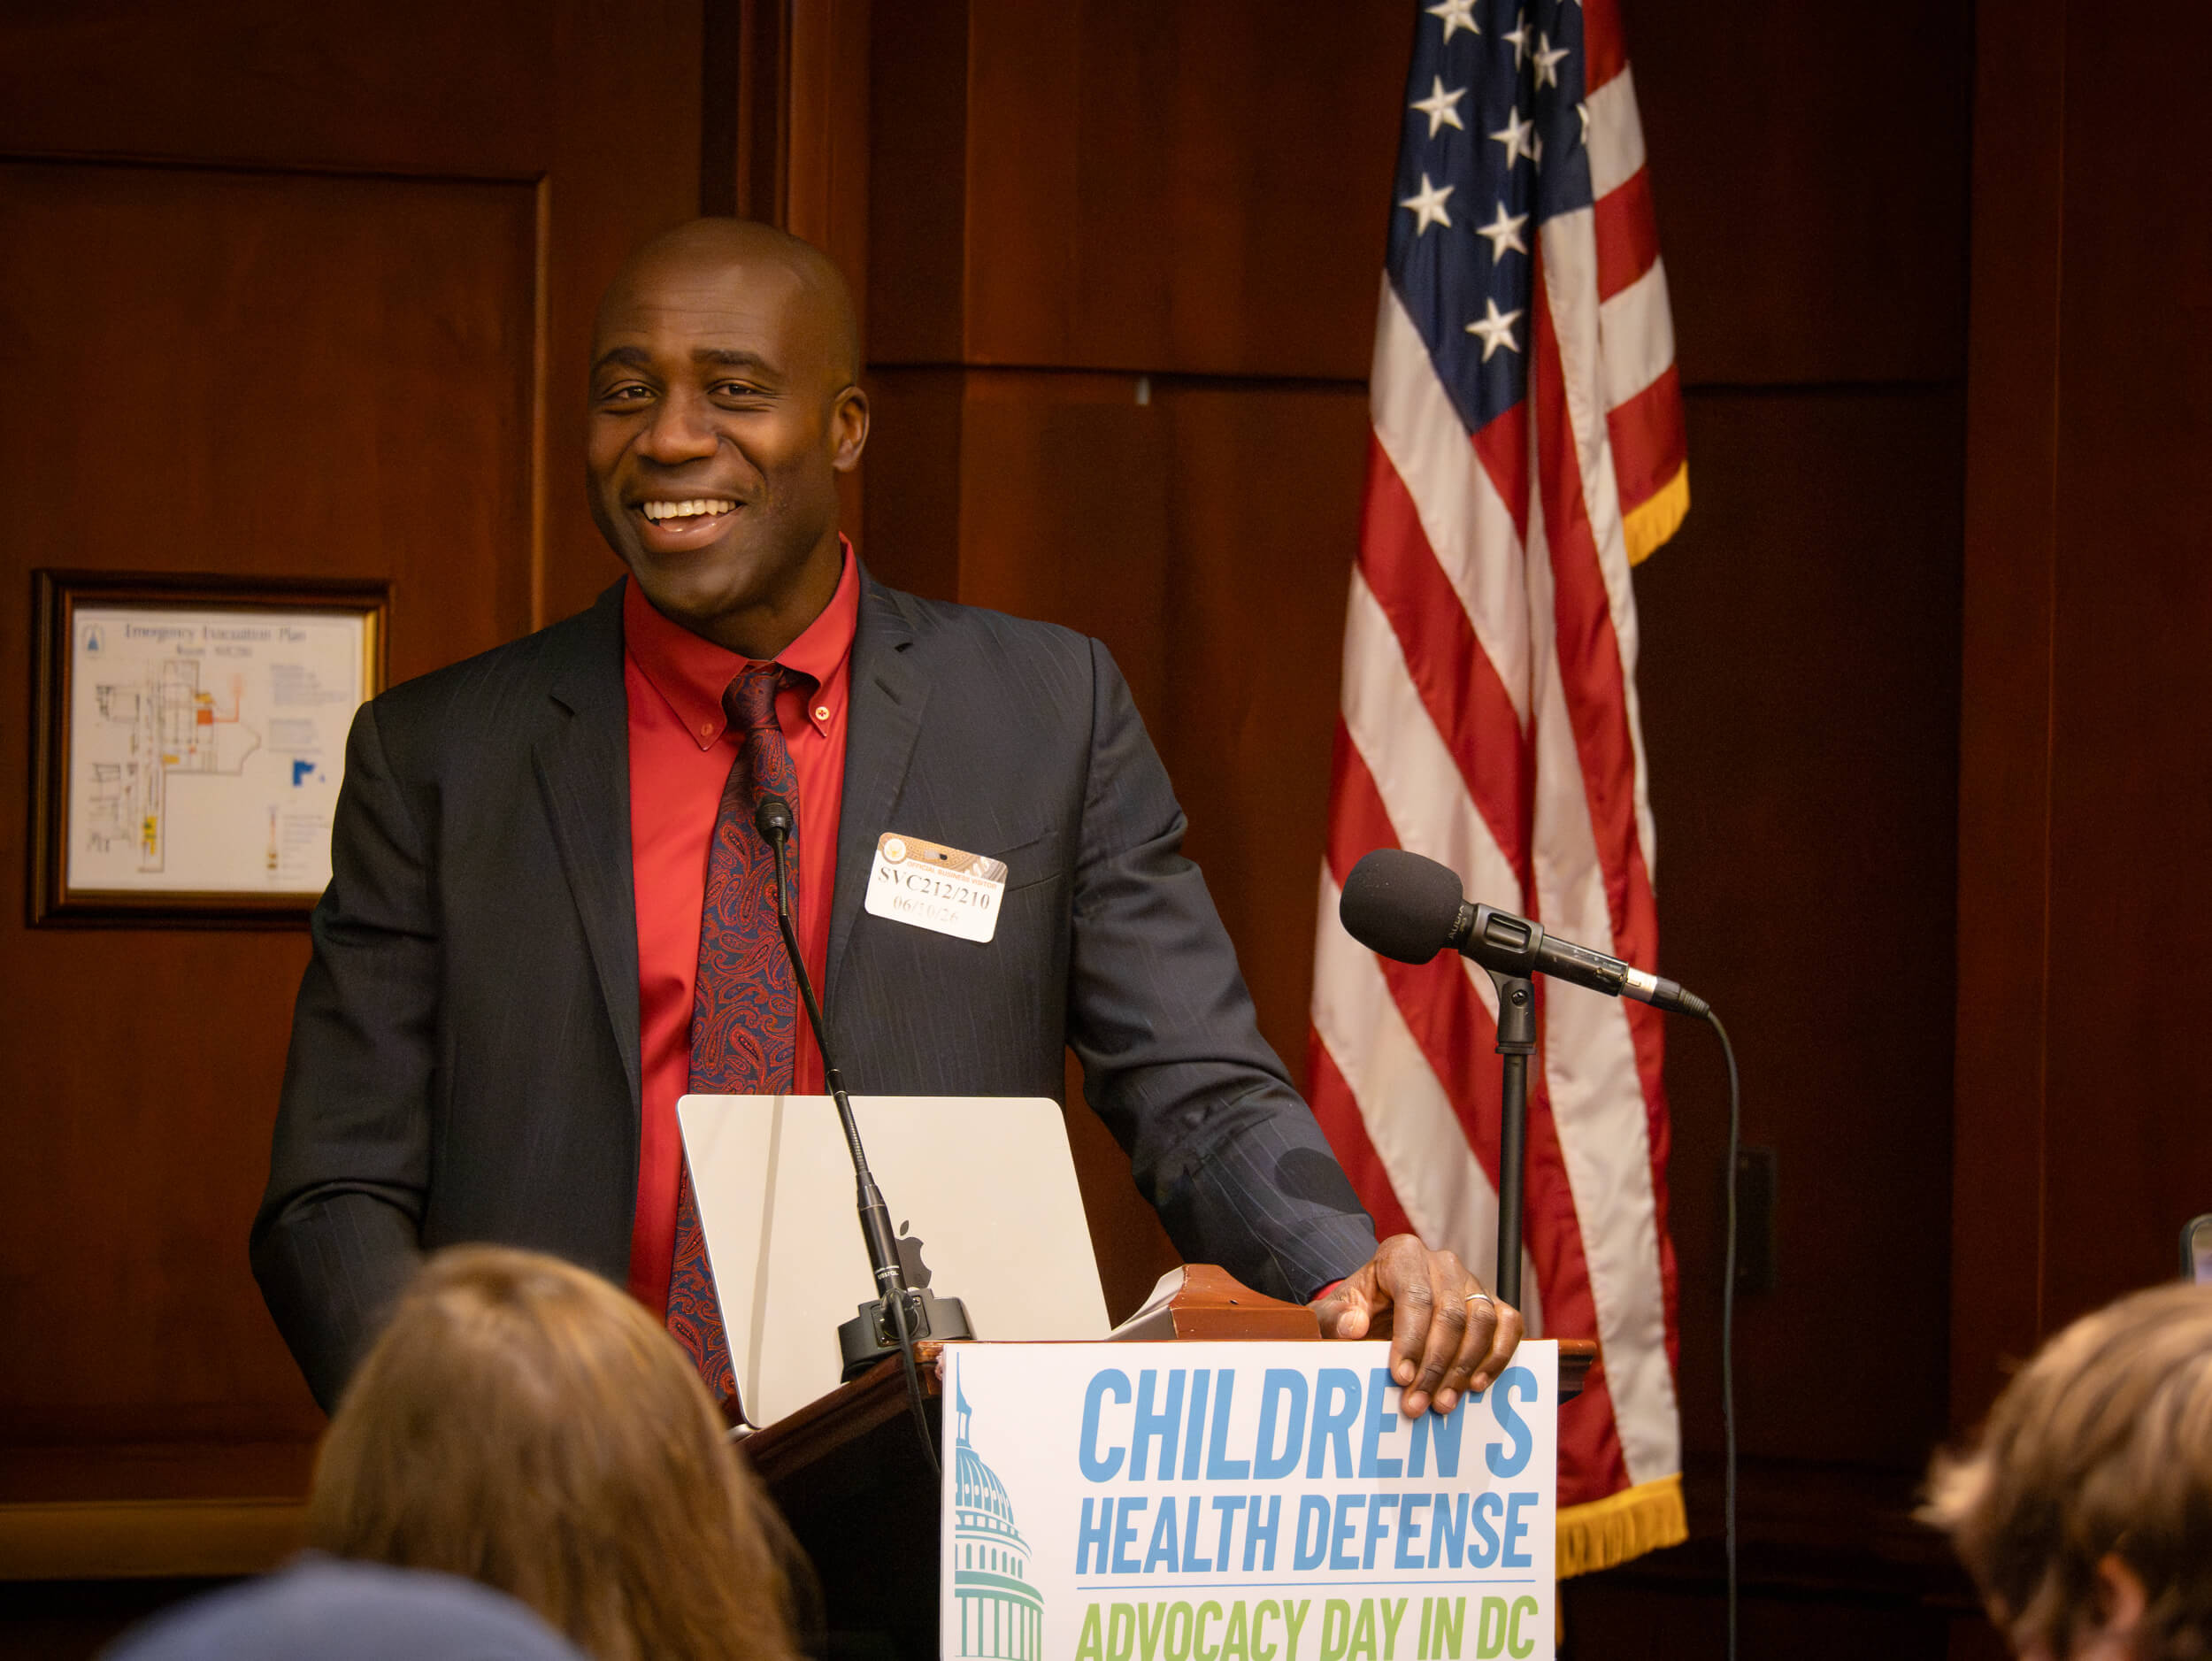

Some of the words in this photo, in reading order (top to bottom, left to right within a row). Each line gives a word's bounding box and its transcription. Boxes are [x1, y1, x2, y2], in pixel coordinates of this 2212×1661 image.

[124, 623, 196, 642] Emergency
[204, 625, 272, 640] Evacuation
[279, 626, 307, 642] Plan
[879, 866, 990, 910] SVC212/210
[906, 861, 935, 873] OFFICIAL
[937, 868, 971, 883] BUSINESS
[972, 876, 998, 890] VISITOR
[1075, 1496, 1282, 1574] HEALTH
[1293, 1492, 1539, 1571] DEFENSE
[1074, 1599, 1311, 1661] ADVOCACY
[1319, 1598, 1409, 1661] DAY
[1417, 1596, 1466, 1661] IN
[1476, 1595, 1539, 1660] DC
